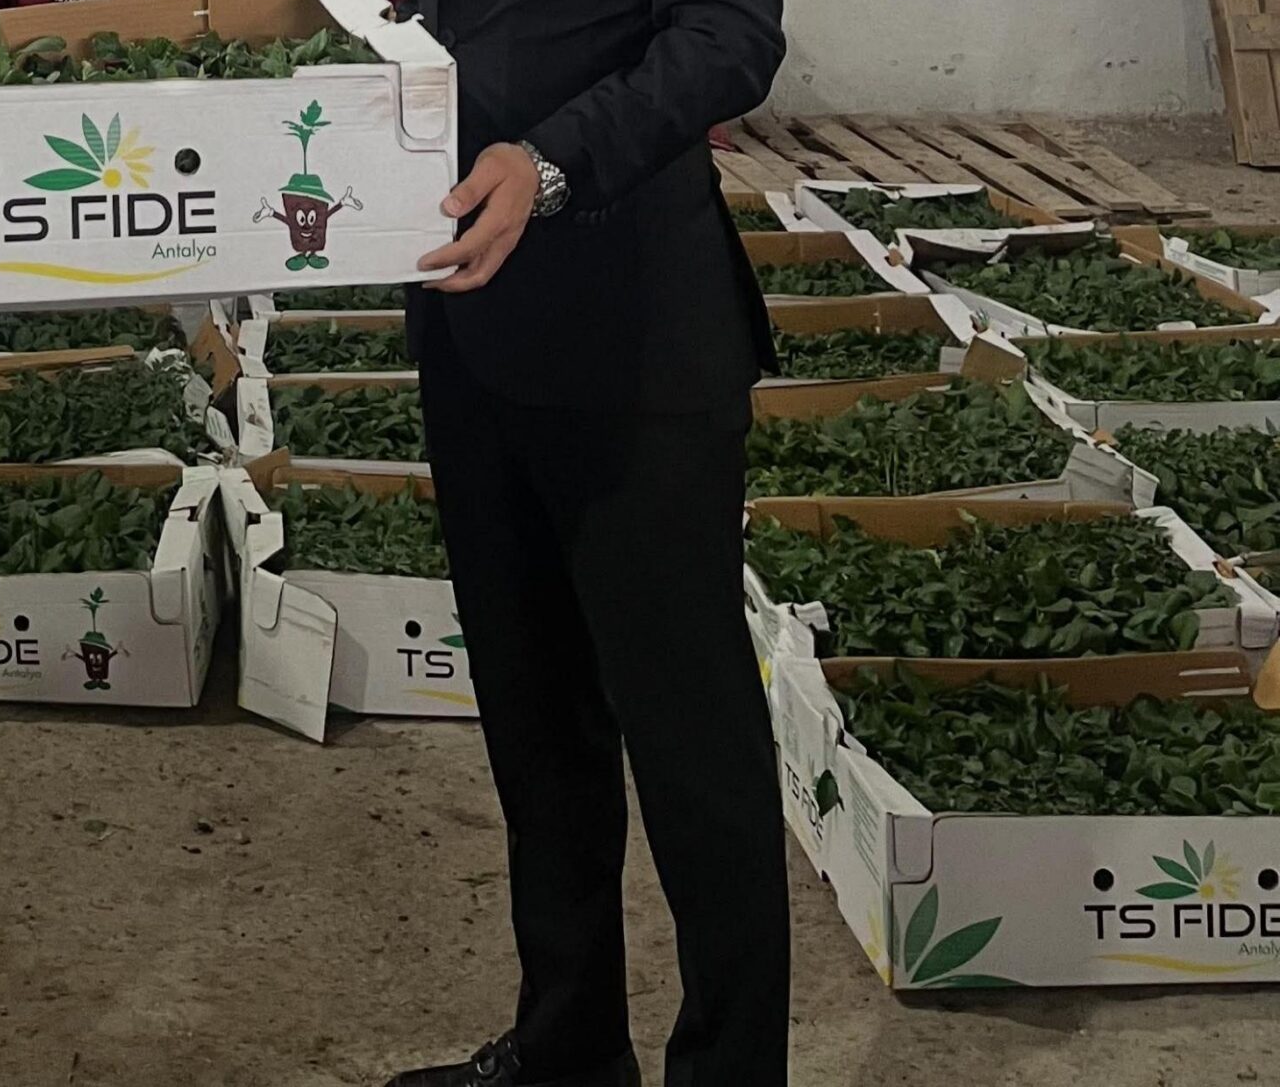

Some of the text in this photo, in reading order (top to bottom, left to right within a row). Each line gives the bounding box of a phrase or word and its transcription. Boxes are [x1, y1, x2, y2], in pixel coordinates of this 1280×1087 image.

[71, 191, 217, 239] FIDE
[151, 239, 217, 262] Antalya
[2, 667, 43, 681] Antalya
[396, 648, 455, 679] TS
[1084, 903, 1280, 940] TS FIDE
[1238, 940, 1280, 960] Antaly
